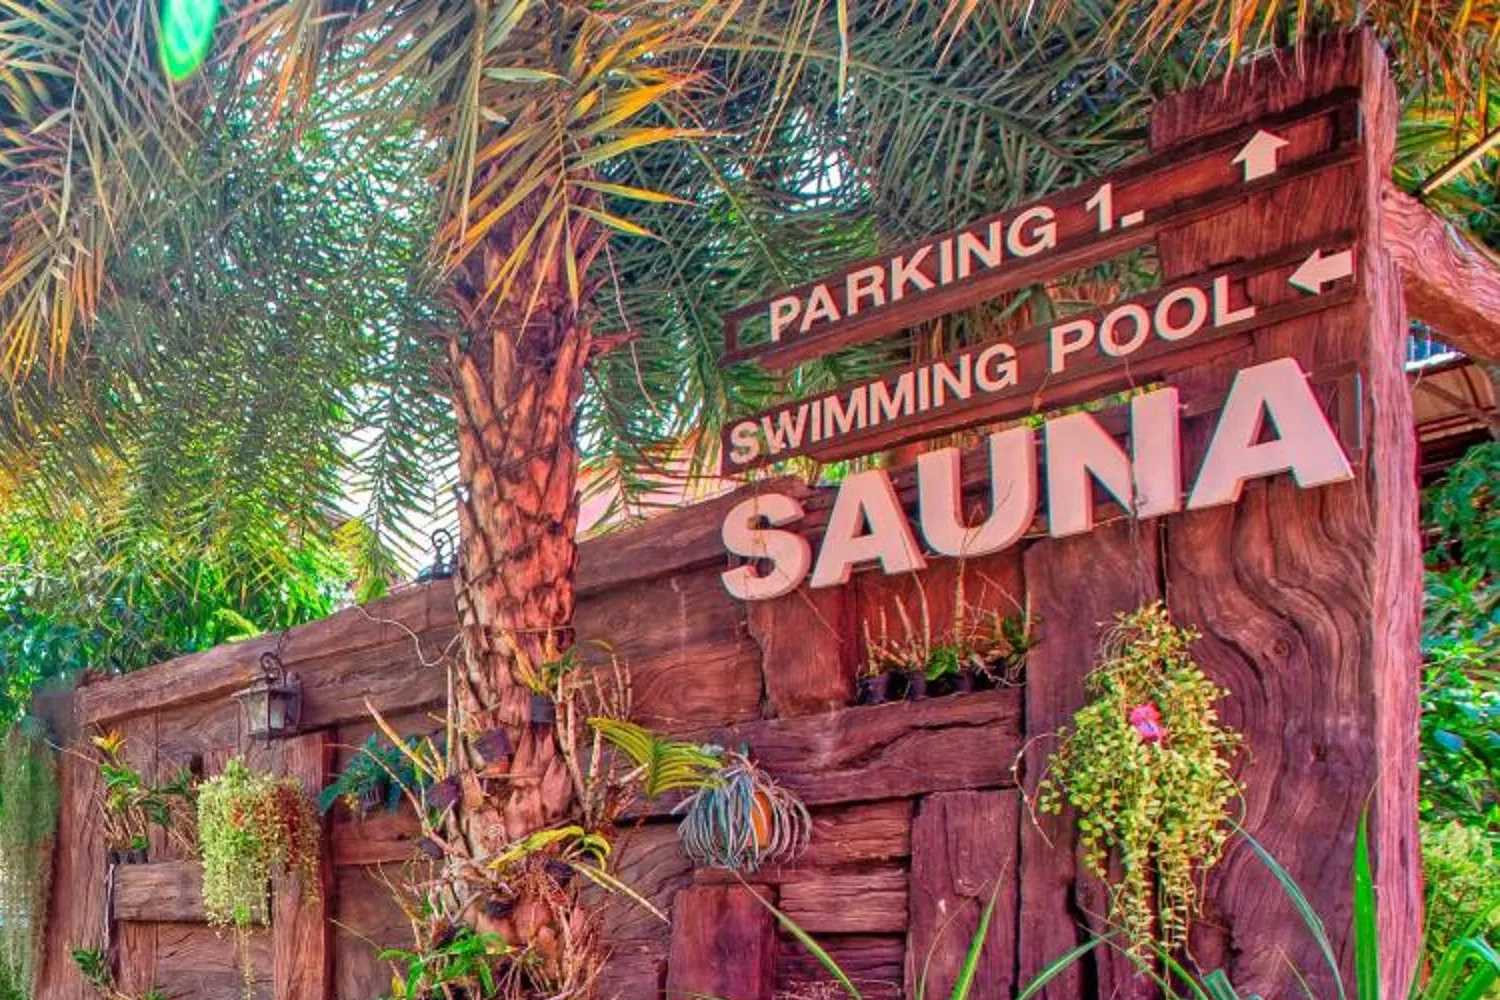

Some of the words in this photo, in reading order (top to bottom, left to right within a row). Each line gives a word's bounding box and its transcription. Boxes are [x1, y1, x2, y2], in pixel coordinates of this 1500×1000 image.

[769, 205, 1058, 342] PARKING
[1085, 182, 1146, 231] 1.
[729, 343, 1018, 465] SWIMMING
[1049, 275, 1257, 374] POOL
[721, 356, 1355, 601] SAUNA
